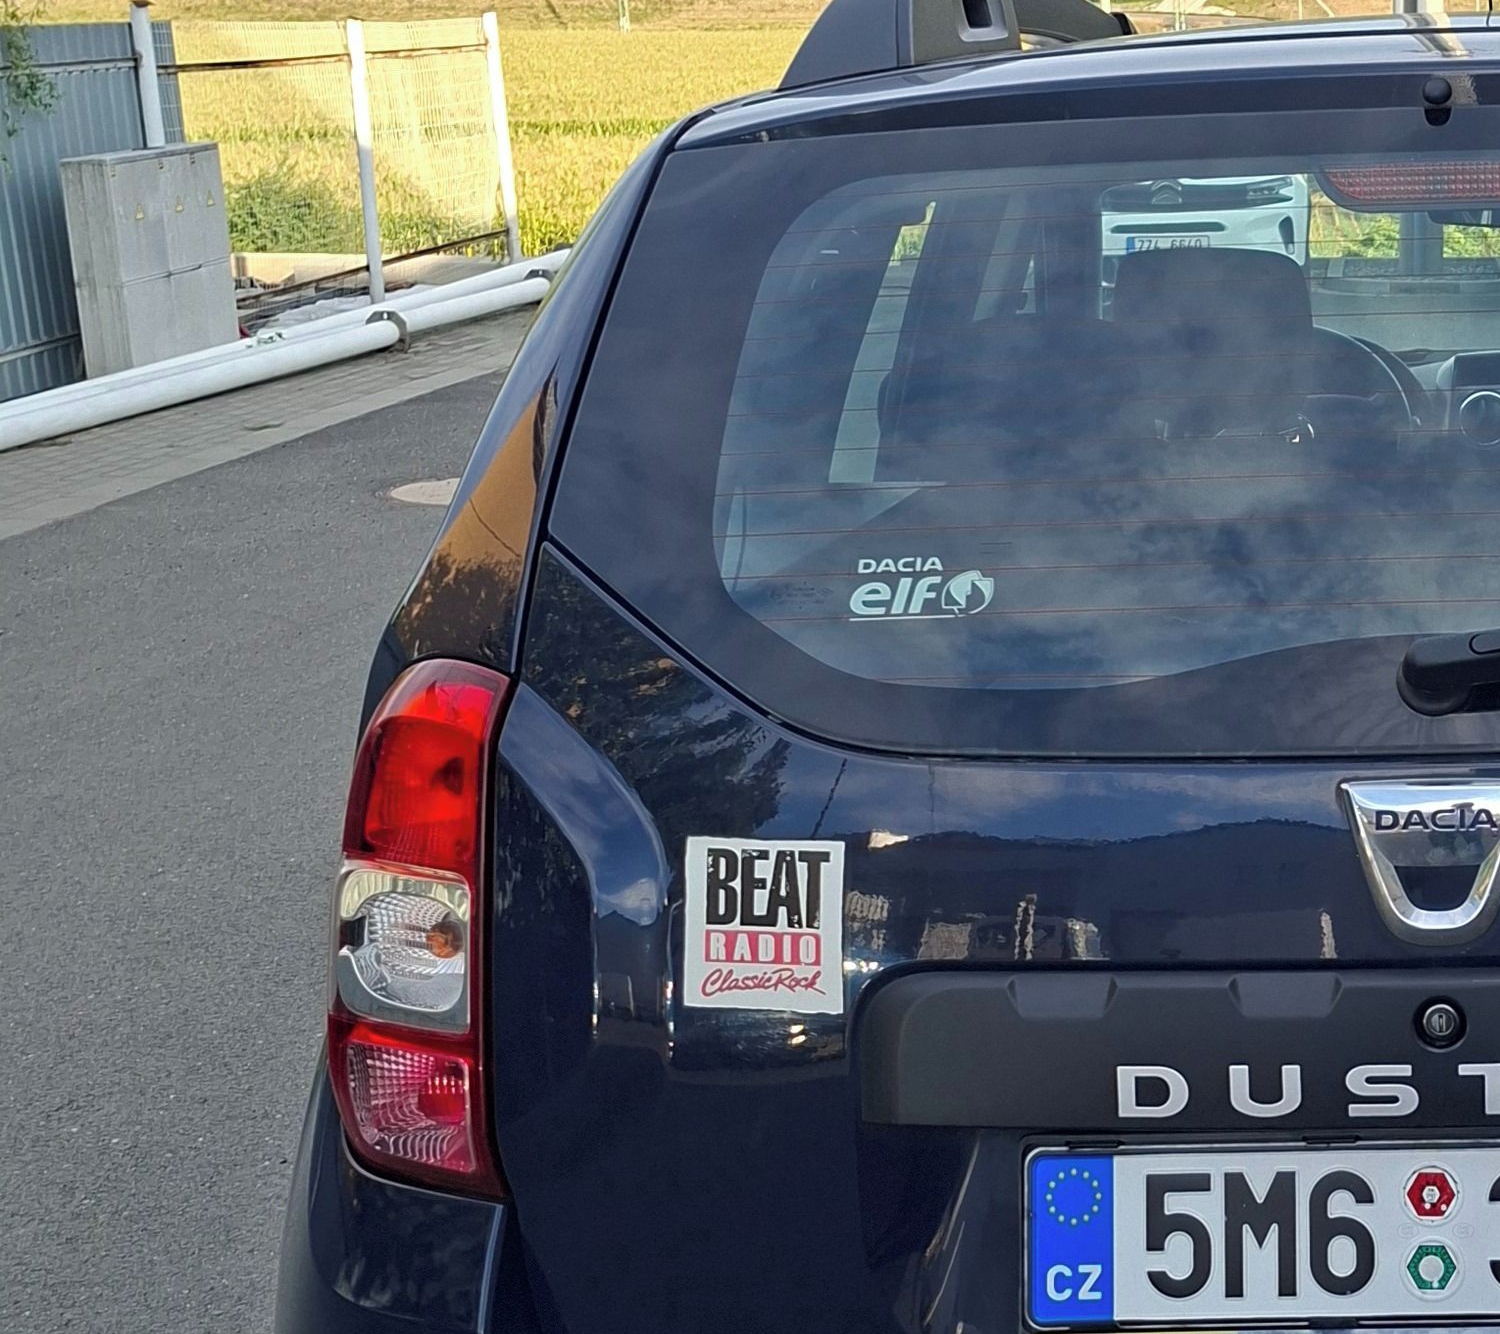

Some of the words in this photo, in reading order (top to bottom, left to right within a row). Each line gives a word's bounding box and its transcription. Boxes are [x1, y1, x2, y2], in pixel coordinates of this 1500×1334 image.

[857, 556, 943, 573] DACIA
[850, 576, 942, 615] elf
[1374, 808, 1498, 832] DACIA
[705, 847, 831, 929] BEAT
[709, 931, 817, 964] RADIO
[1144, 1168, 1377, 1299] 5M6
[1046, 1264, 1102, 1301] CZ
